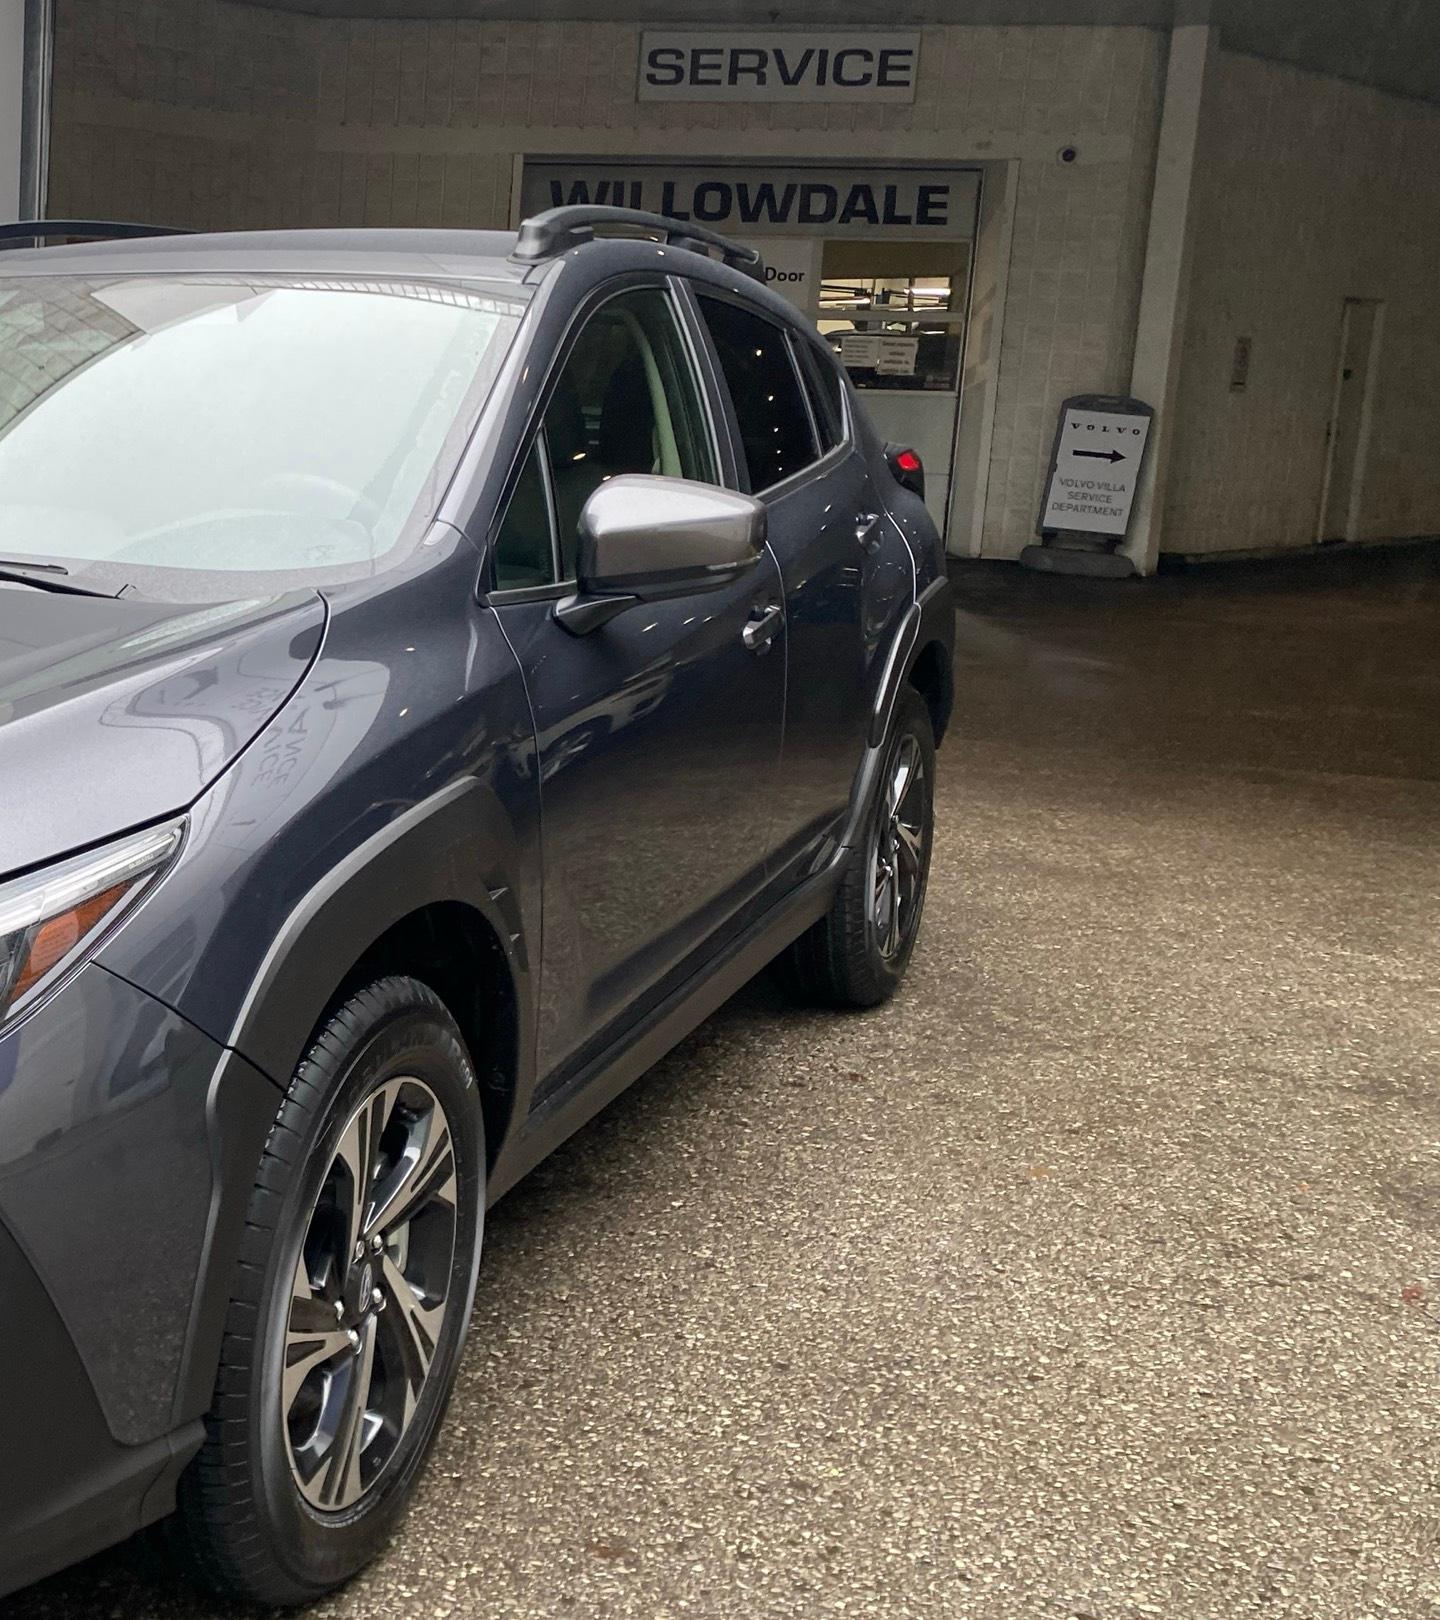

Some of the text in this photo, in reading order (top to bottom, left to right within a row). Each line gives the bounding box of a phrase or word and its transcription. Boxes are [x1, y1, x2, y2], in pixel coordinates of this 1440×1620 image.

[646, 48, 913, 87] SERVICE
[550, 180, 950, 226] WILLOWDALE
[764, 266, 805, 282] Door
[1071, 422, 1141, 436] VOLVO
[1060, 478, 1126, 493] VOLVO VILLA
[1067, 490, 1113, 504] SERVICE
[1051, 502, 1124, 517] DEPARTMENT
